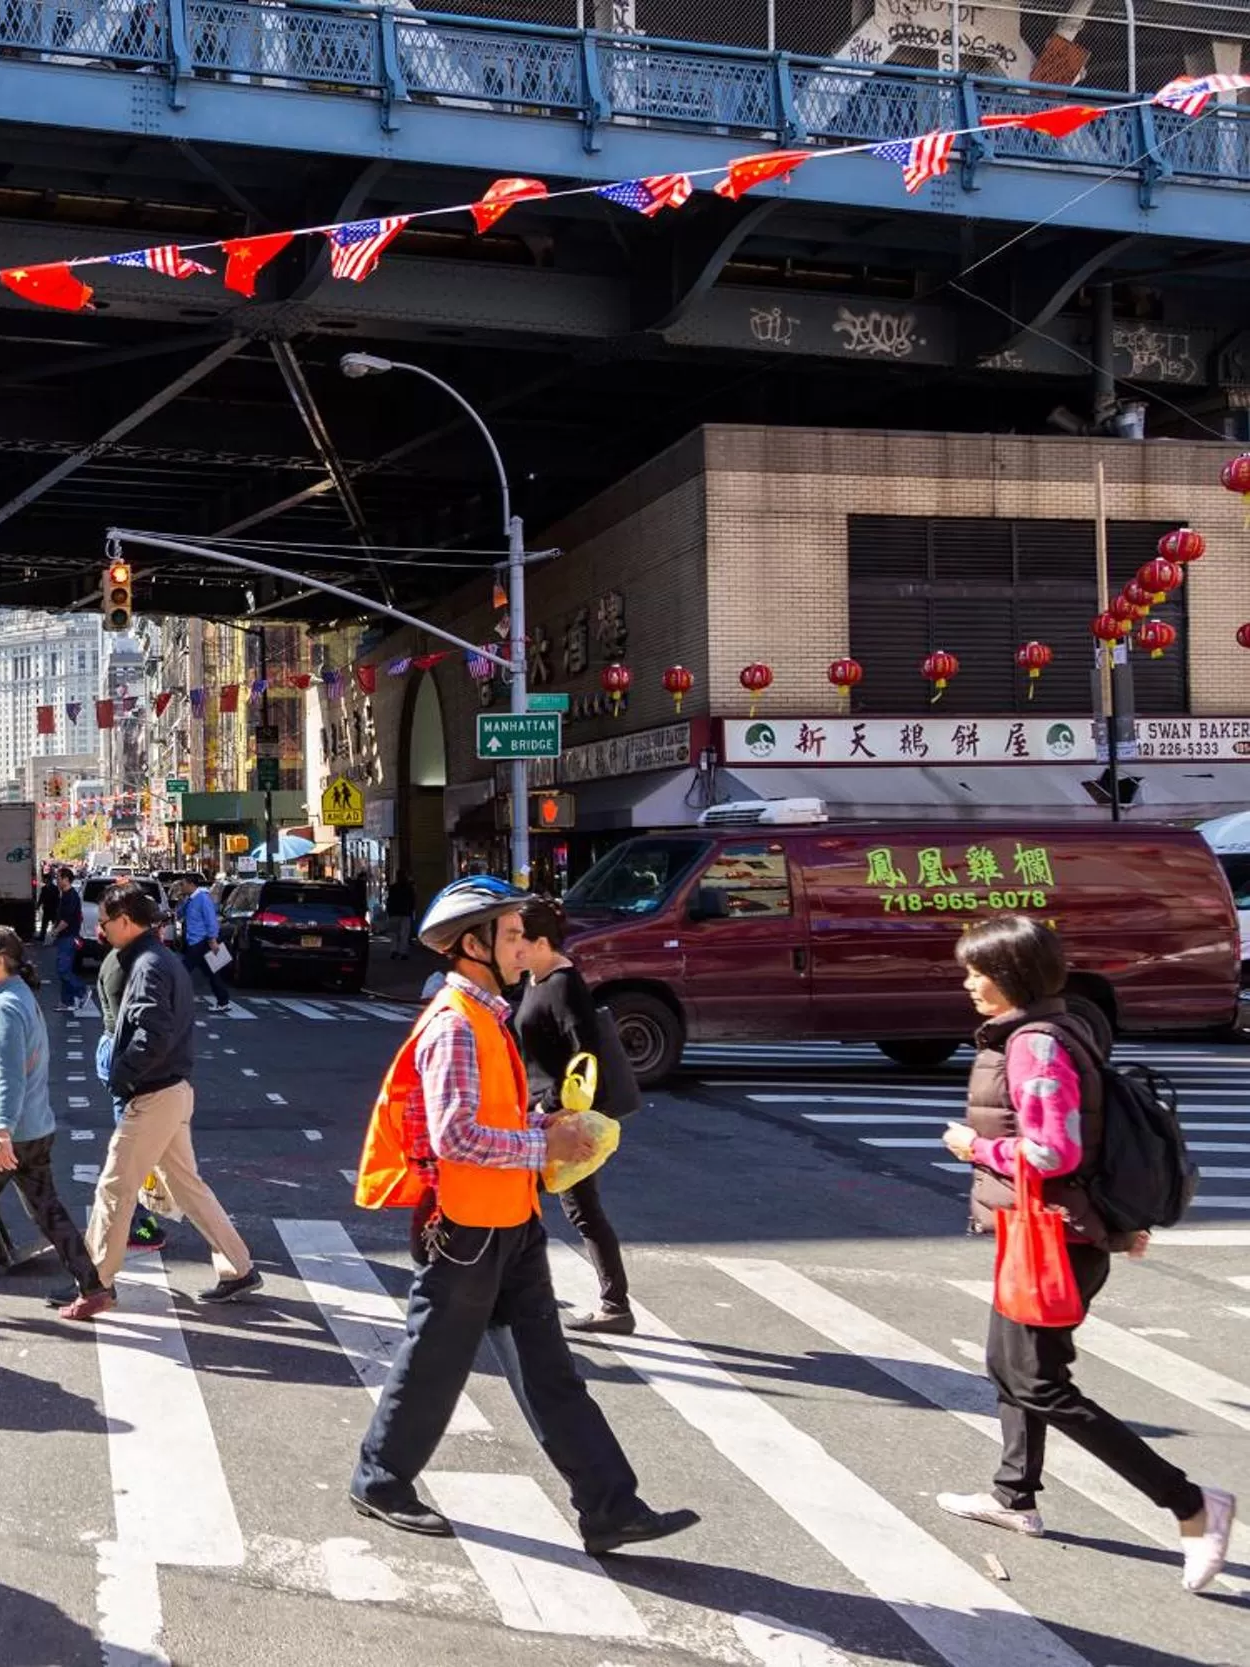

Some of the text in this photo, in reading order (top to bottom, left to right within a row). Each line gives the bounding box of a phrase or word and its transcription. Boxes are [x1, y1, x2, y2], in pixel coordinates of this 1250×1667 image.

[484, 720, 555, 732] MANHATTAN
[1149, 722, 1192, 740] SWAN
[511, 740, 554, 752] BRIDGE
[795, 722, 1030, 758] 新天鵝餅屋
[326, 810, 360, 821] AHEAD
[866, 843, 1055, 889] 鳳凰雞欄
[880, 890, 1047, 912] 718-965-6078
